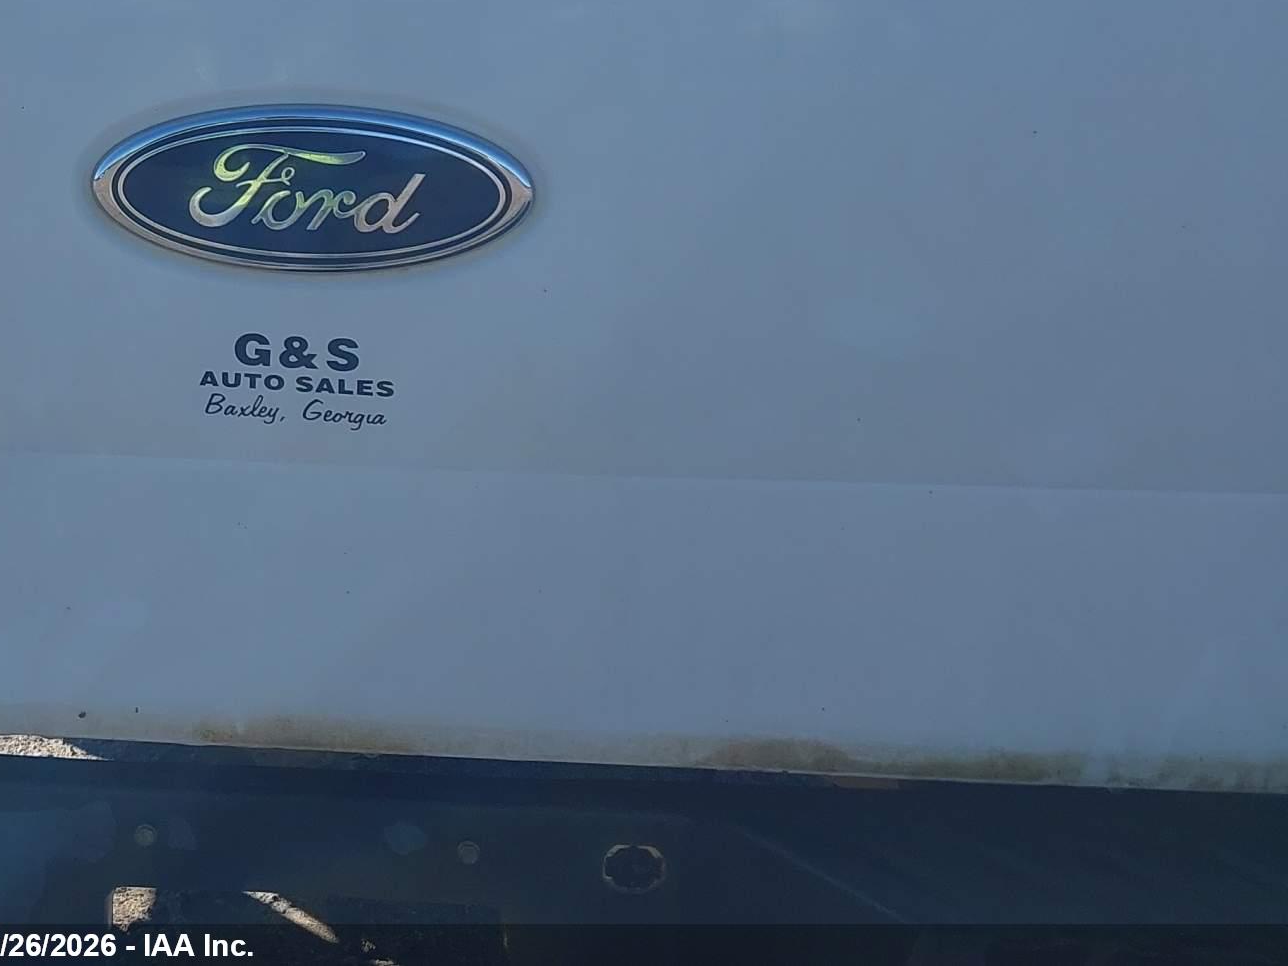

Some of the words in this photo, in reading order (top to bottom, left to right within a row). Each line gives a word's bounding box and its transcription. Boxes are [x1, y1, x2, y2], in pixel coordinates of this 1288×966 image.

[188, 143, 426, 234] Ford
[199, 370, 285, 391] AUTO
[295, 376, 395, 397] SALES
[204, 393, 286, 424] Baxley,
[302, 399, 387, 431] Georgia
